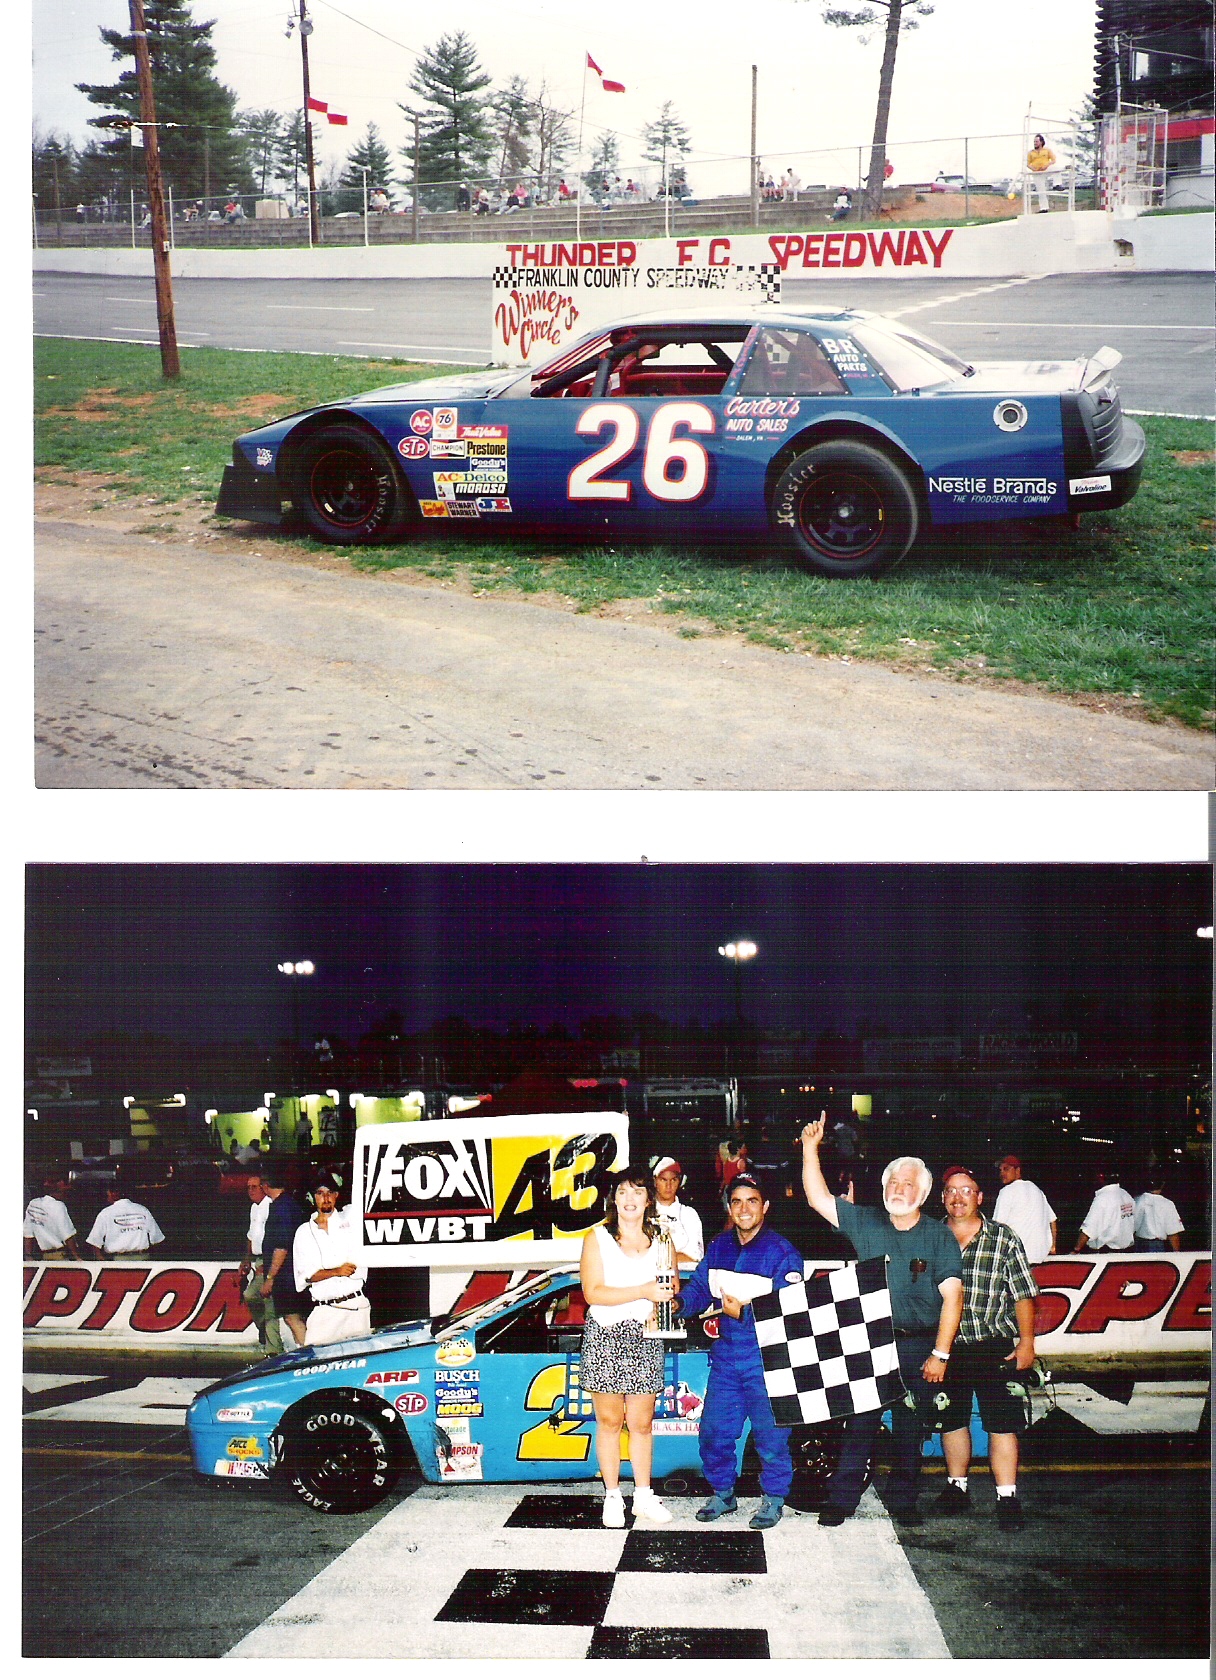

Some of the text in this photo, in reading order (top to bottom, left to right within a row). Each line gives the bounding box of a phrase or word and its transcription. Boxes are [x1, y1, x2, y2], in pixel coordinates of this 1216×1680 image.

[762, 229, 954, 270] SPEEDWAY
[517, 267, 728, 289] FRANKLIN COUNTY SPEEDWAY
[495, 289, 580, 346] Winner's
[520, 316, 560, 360] Circle
[833, 353, 859, 363] AUTO
[837, 362, 867, 372] PARTS
[724, 396, 800, 418] Carter's
[413, 415, 430, 428] AC
[439, 413, 452, 424] 76
[725, 418, 789, 433] AUTO SALES
[402, 438, 426, 455] STP
[467, 441, 505, 455] Prestone
[567, 401, 716, 502] 26
[472, 459, 505, 468] Goody's
[456, 483, 506, 494] MOROSO
[994, 478, 1057, 494] Brands
[1075, 484, 1107, 493] Valvoline
[953, 495, 1051, 504] THE FOODSERVICE COMPANY
[450, 509, 478, 517] WARNER
[379, 1133, 618, 1240] FOX 43
[364, 1216, 492, 1243] WVBT
[23, 1267, 253, 1333] PTON
[365, 1370, 418, 1385] ARP
[435, 1370, 480, 1382] BUSCH
[436, 1388, 478, 1399] Goody's
[399, 1394, 424, 1412] STP
[437, 1402, 482, 1415] MOOG
[440, 1445, 478, 1456] SMPSON
[291, 1477, 333, 1511] EAGLE
